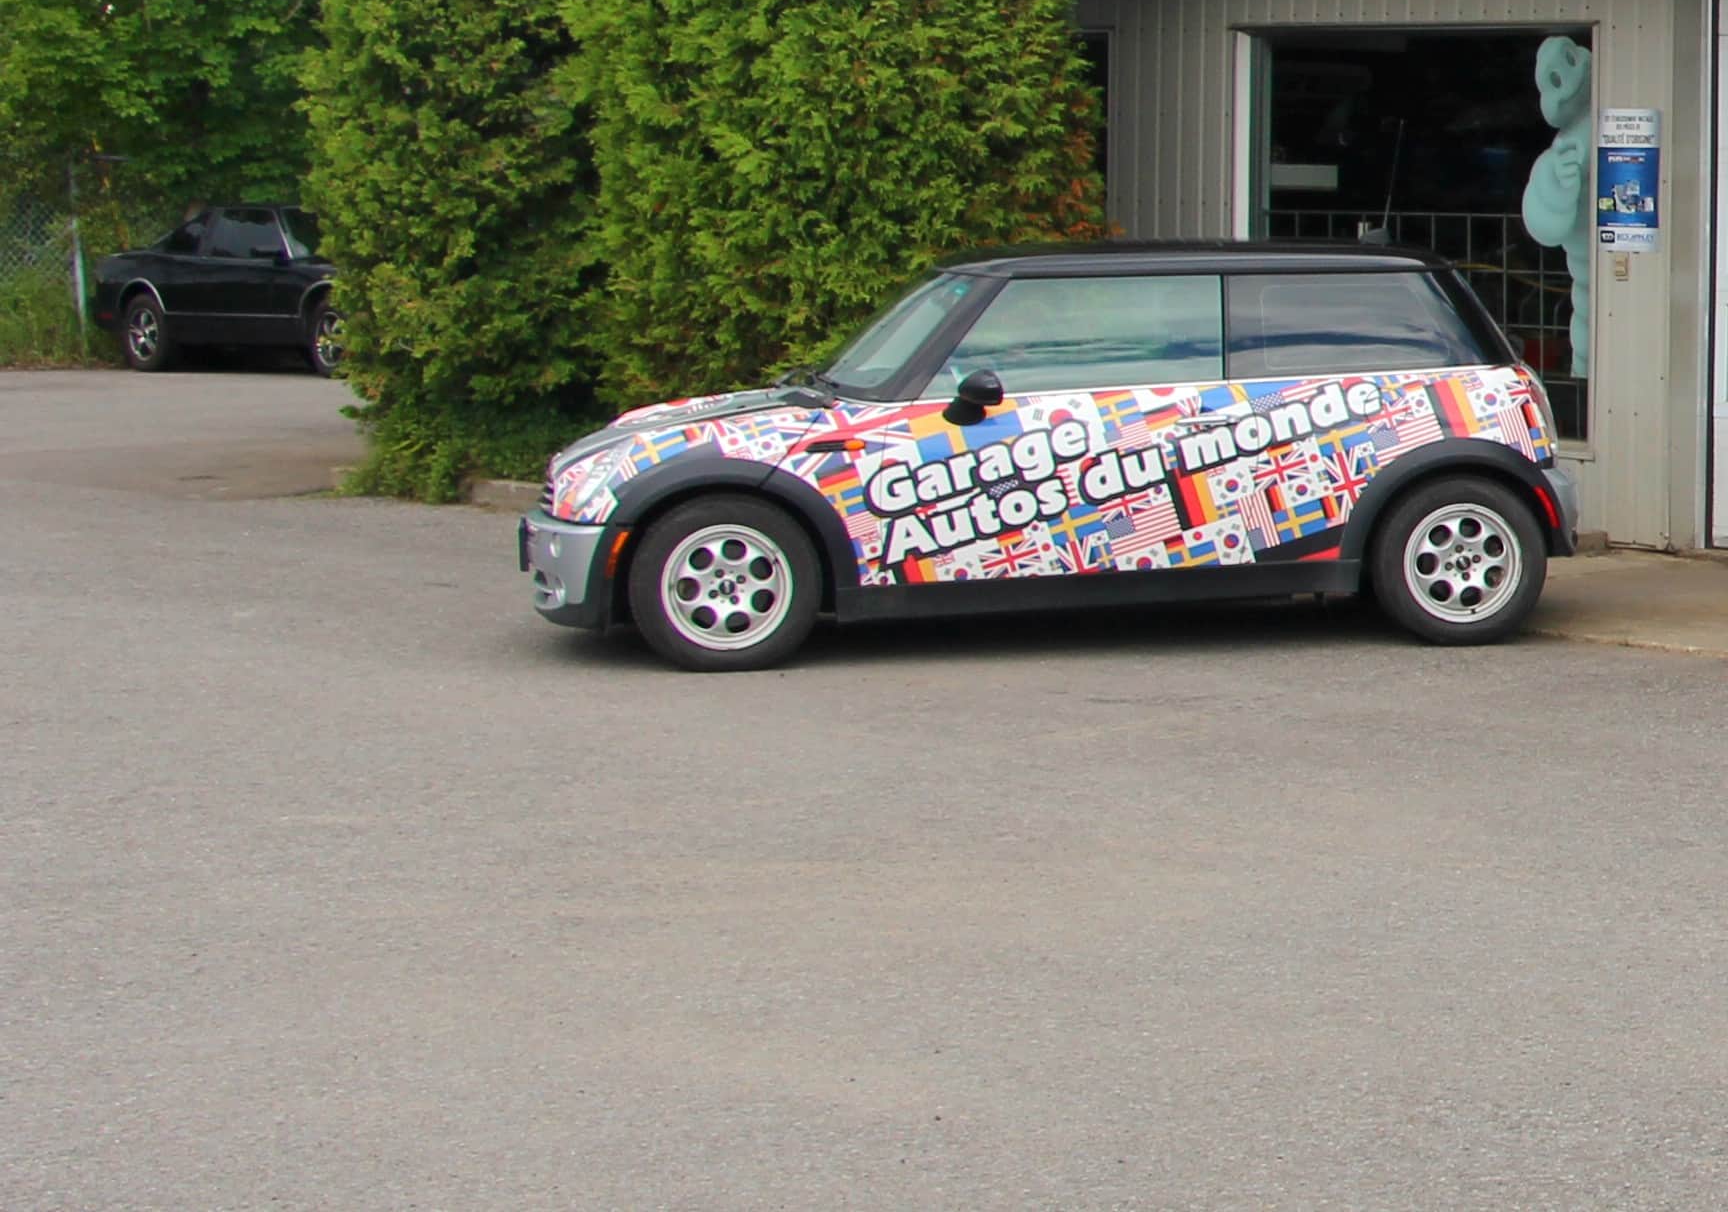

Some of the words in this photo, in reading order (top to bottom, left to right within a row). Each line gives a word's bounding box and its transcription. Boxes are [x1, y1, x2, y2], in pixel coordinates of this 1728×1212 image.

[870, 420, 1088, 512] Garage
[884, 479, 1067, 564] Autos
[1084, 445, 1167, 501] du
[1180, 379, 1383, 471] monde
